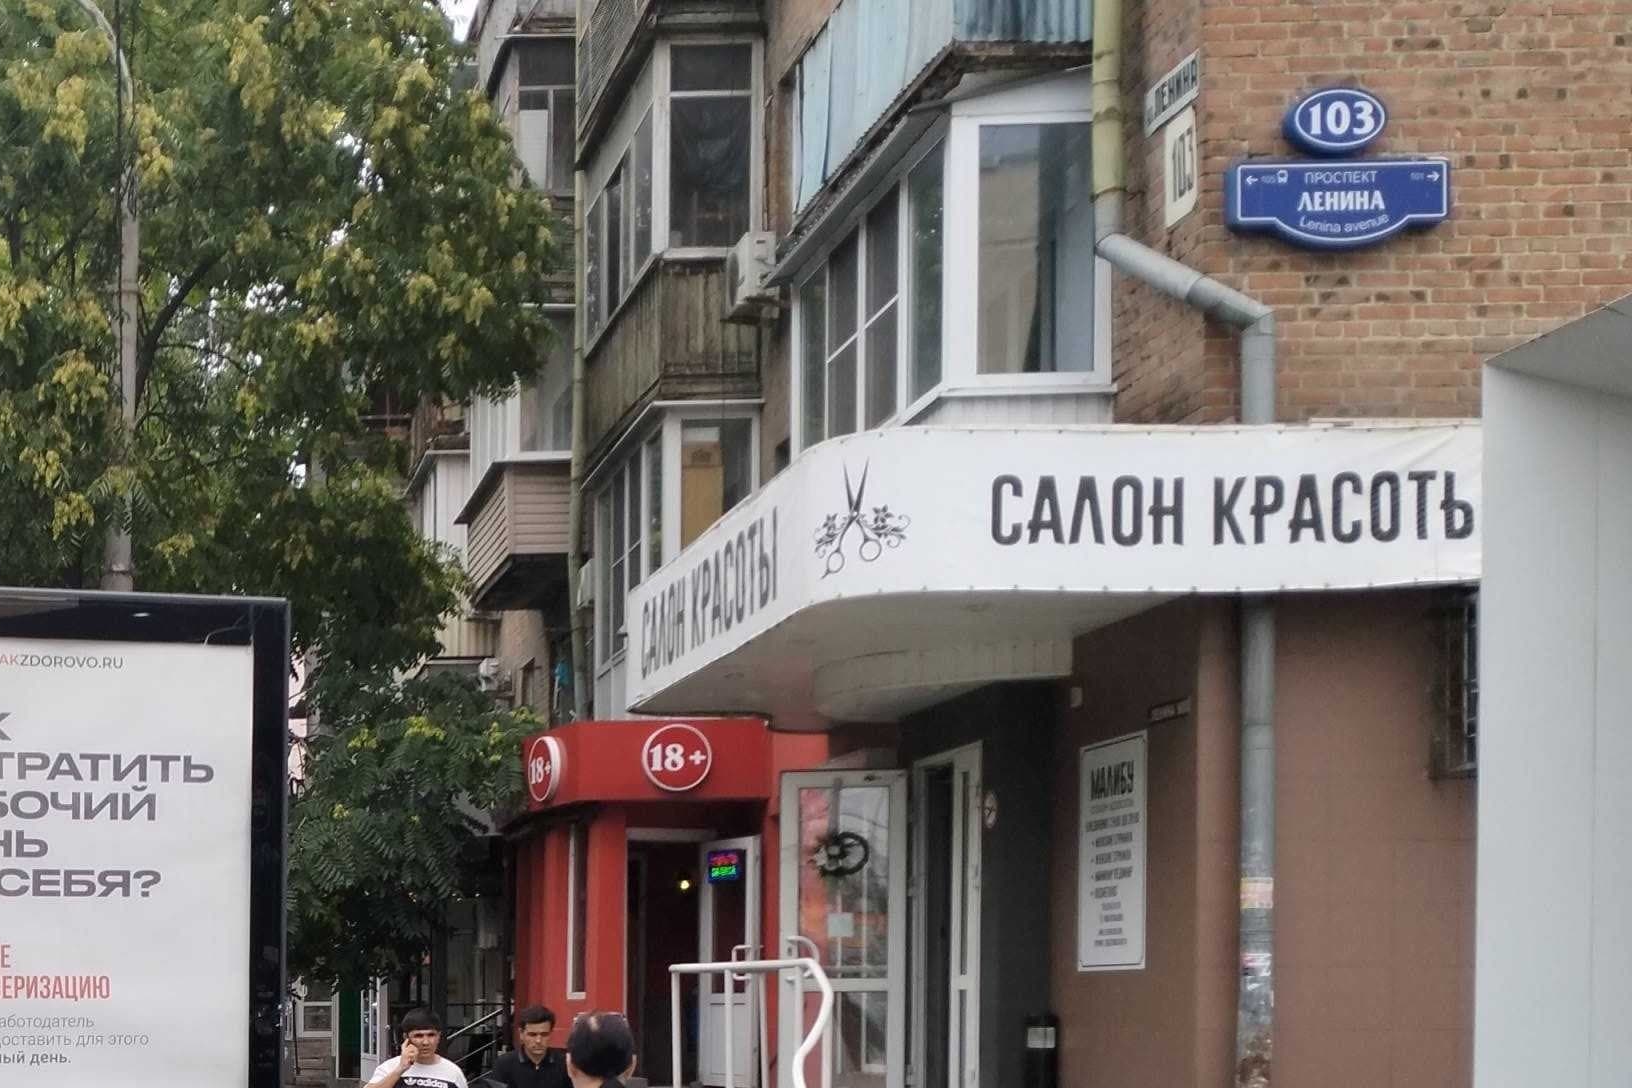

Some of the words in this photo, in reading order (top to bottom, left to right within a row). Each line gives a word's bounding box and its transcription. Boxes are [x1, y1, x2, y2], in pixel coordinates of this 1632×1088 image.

[1309, 100, 1375, 135] 103
[1304, 170, 1378, 184] ПРОСПЕКТ
[1297, 190, 1385, 212] ЛЕНИНА
[1299, 215, 1341, 233] Lenina
[1344, 214, 1389, 232] avenue
[990, 473, 1185, 547] САЛОН
[641, 575, 686, 681] САЛОН
[691, 505, 778, 651] КРАСОТЫ
[649, 743, 706, 772] 18+
[530, 756, 552, 785] 18+
[75, 1032, 104, 1048] для
[107, 1032, 152, 1048] этого
[29, 1050, 72, 1067] день.
[417, 1078, 448, 1088] adidas
